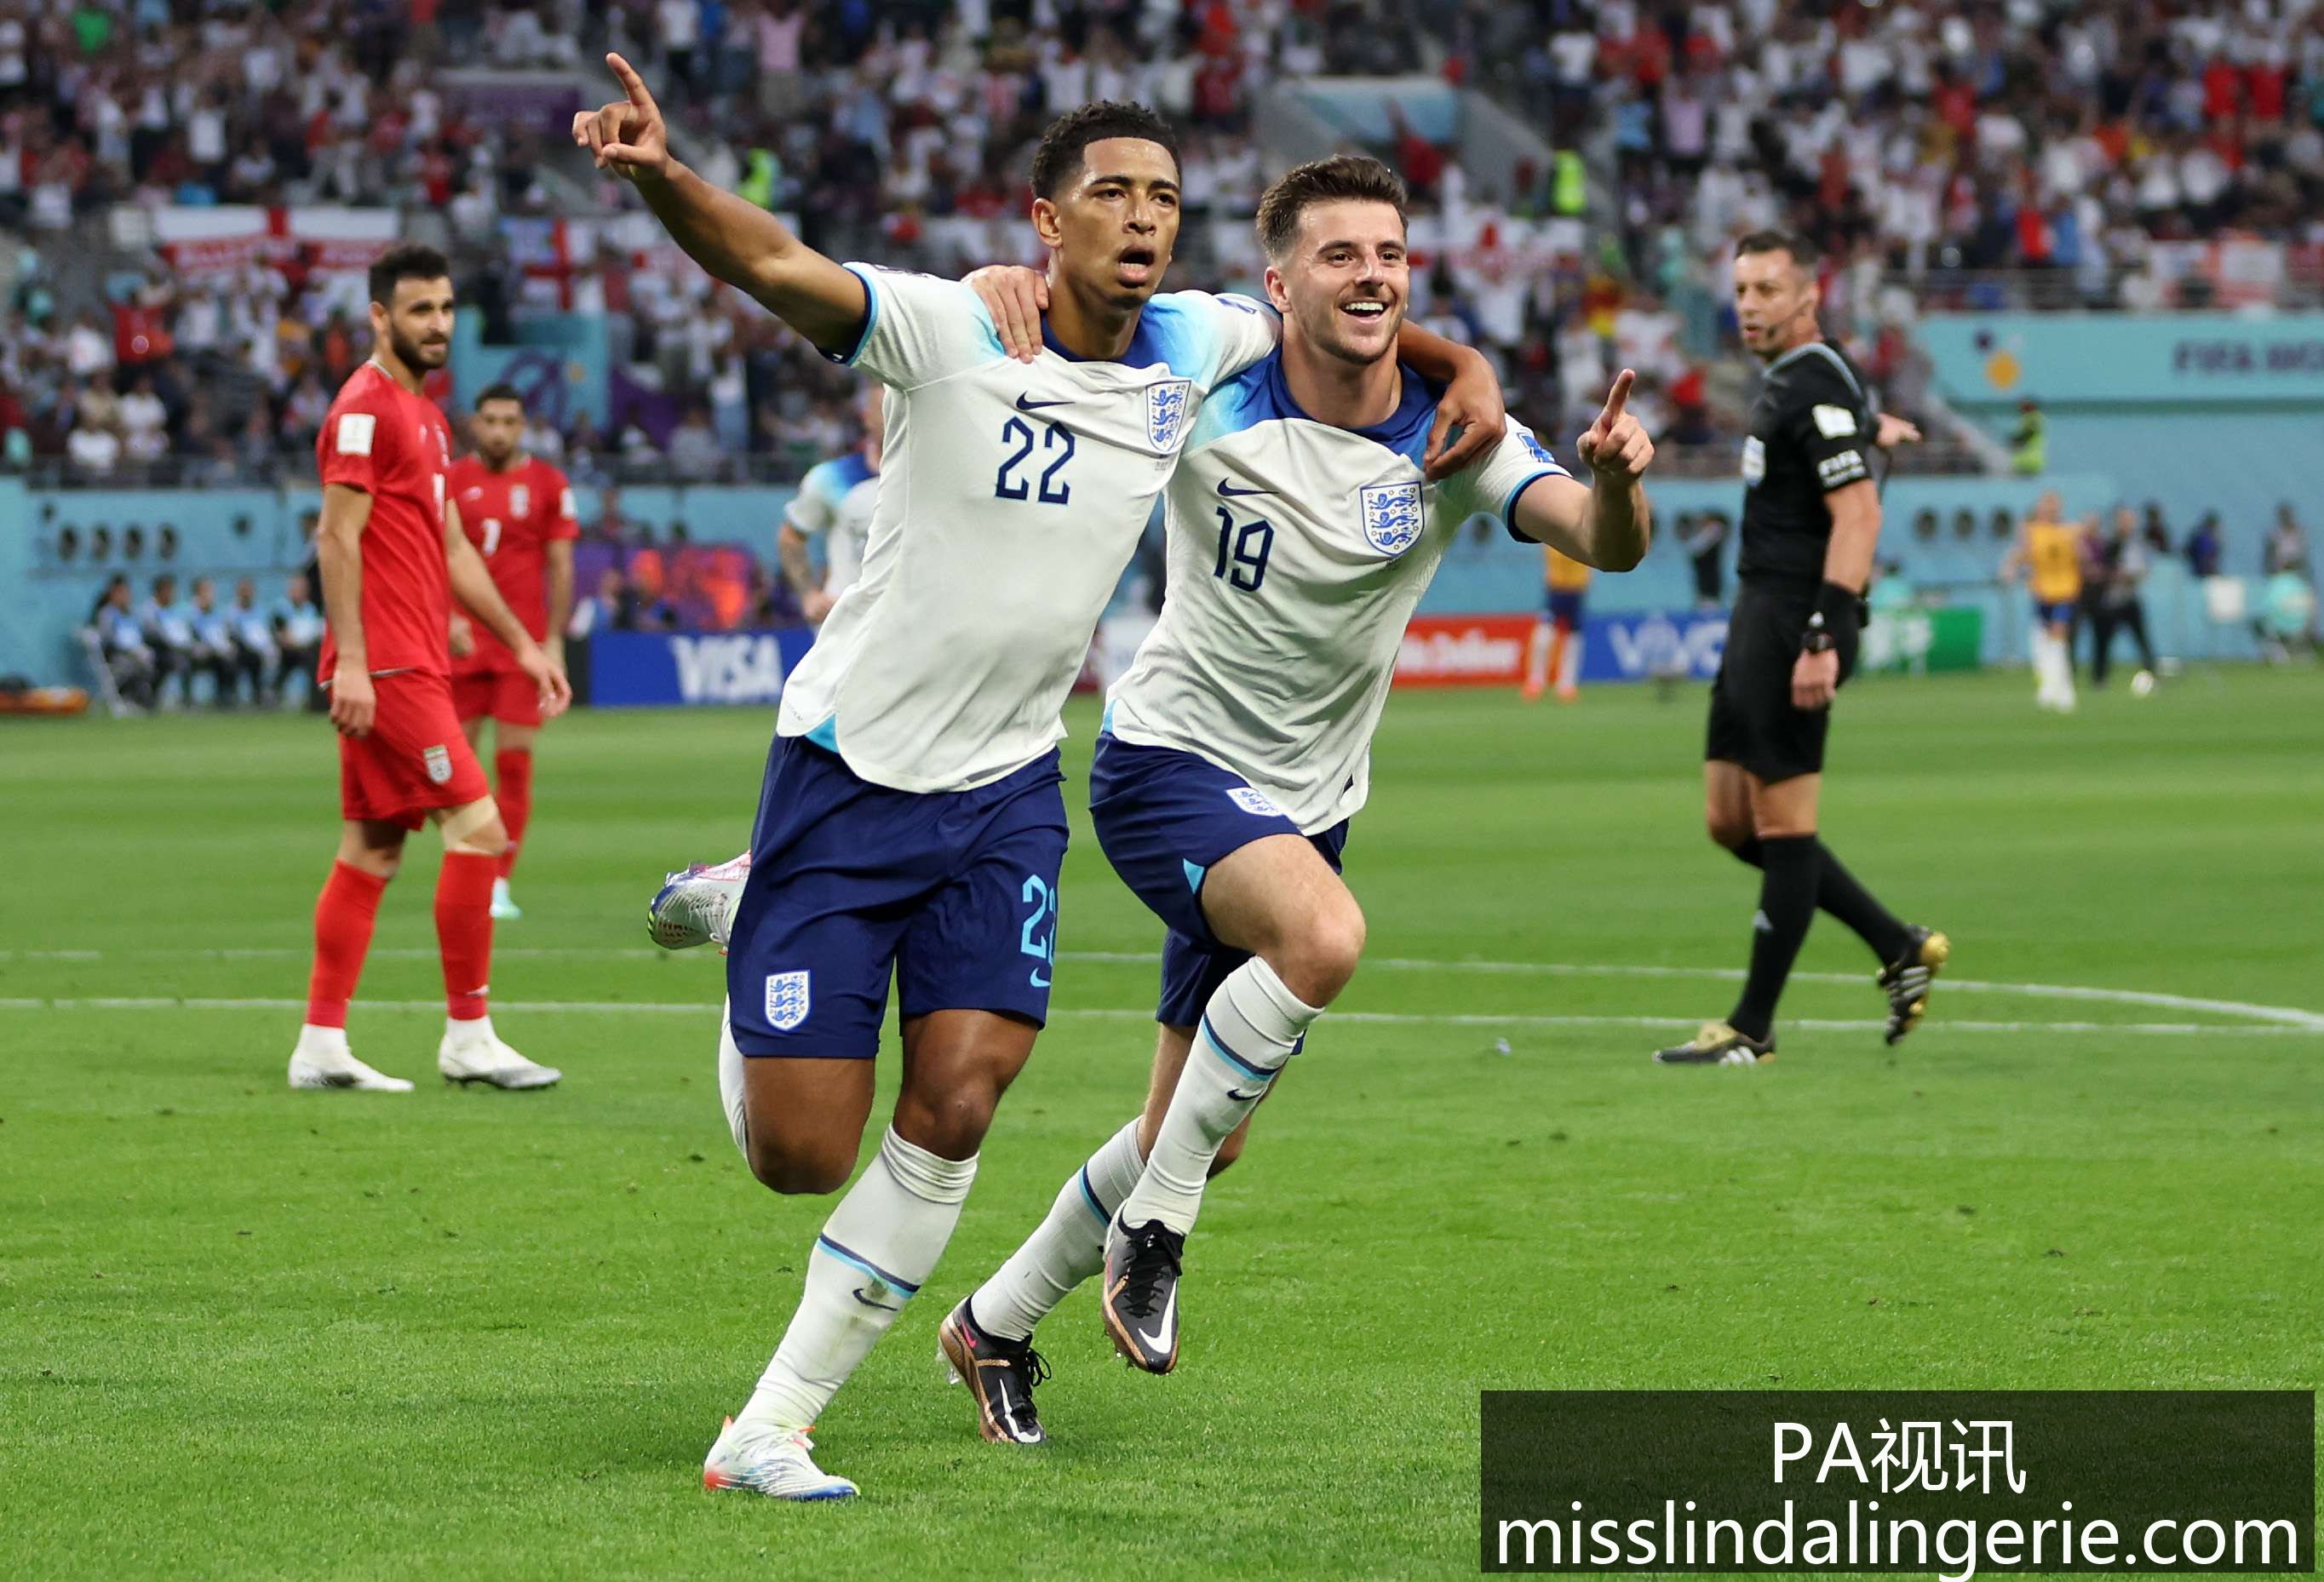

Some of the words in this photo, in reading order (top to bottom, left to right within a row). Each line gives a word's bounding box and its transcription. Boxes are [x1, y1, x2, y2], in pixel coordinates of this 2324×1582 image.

[995, 416, 1076, 505] 22
[1214, 506, 1275, 592] 19
[669, 634, 784, 702] VISA
